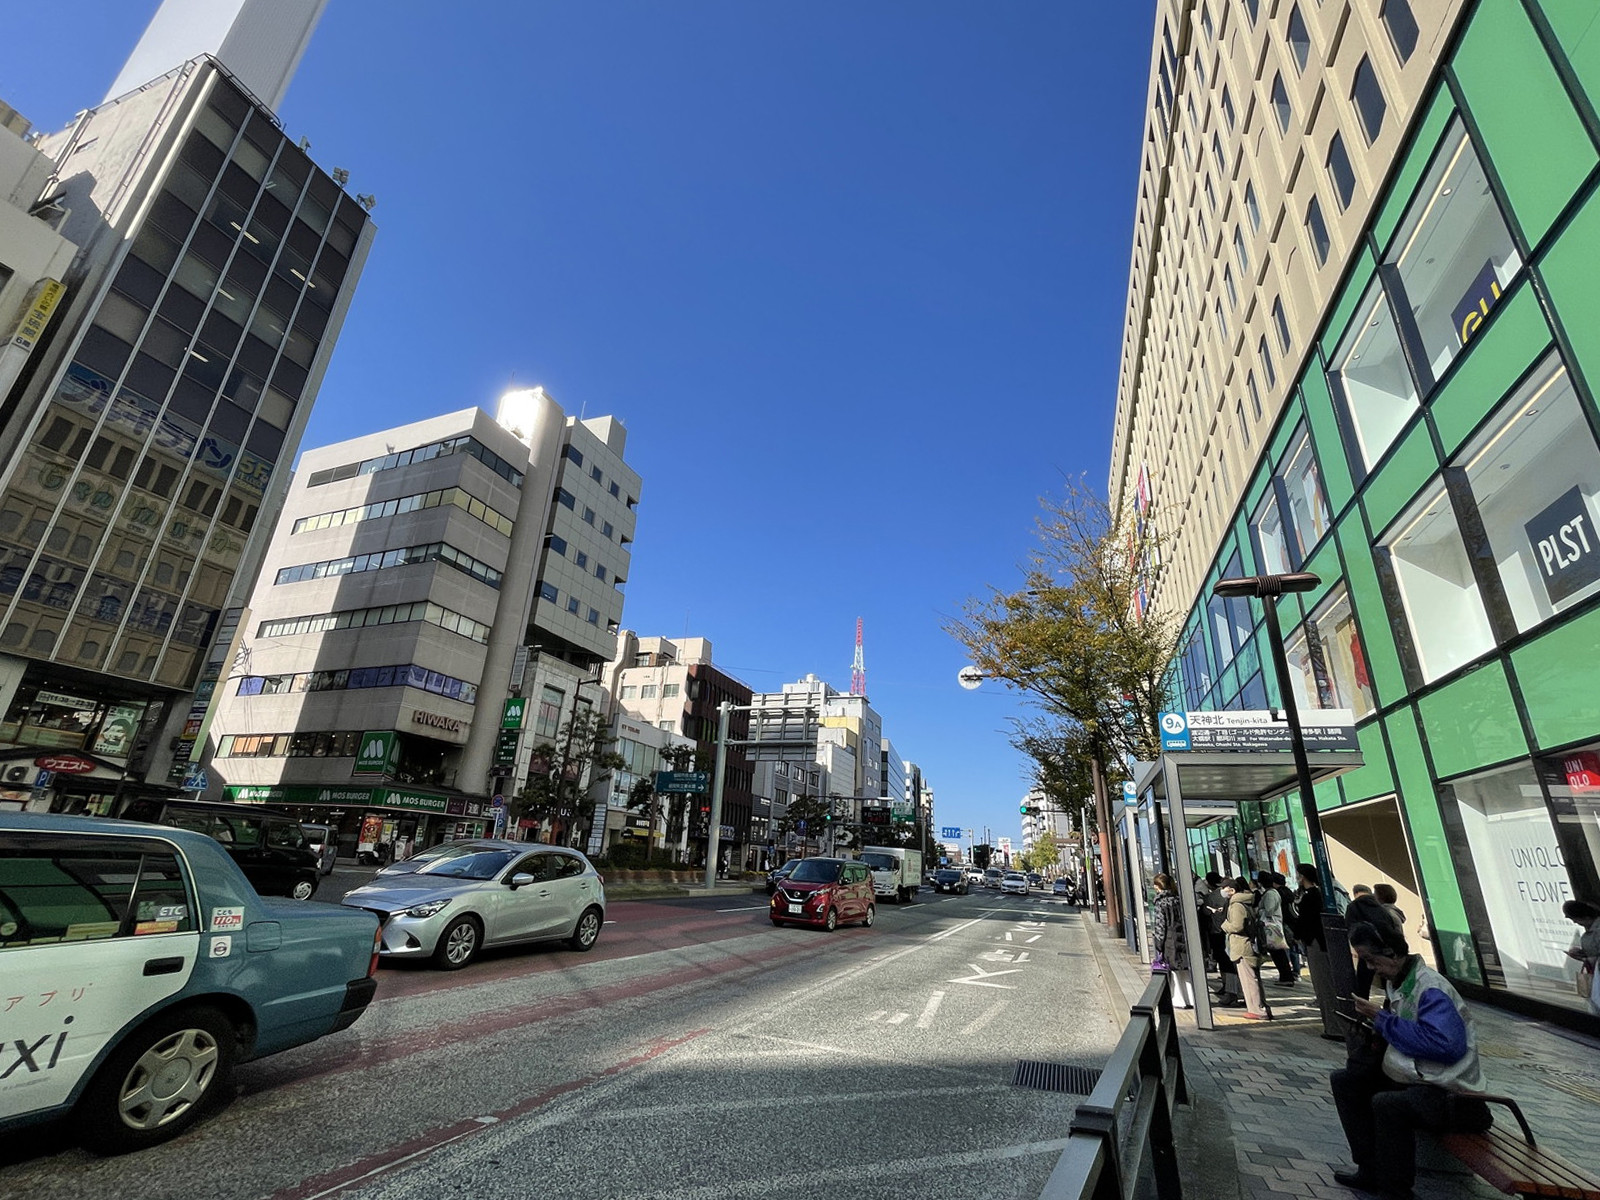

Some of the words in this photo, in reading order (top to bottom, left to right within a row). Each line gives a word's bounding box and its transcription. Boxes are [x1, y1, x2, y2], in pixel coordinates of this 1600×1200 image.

[1538, 514, 1591, 577] PLST
[412, 709, 460, 732] HIWAKA
[1165, 717, 1182, 729] 9A
[1189, 714, 1225, 726] 天神北
[1227, 717, 1268, 726] Tenjin-kita
[44, 759, 90, 770] ウエスト
[1564, 758, 1584, 774] UNI
[1570, 773, 1590, 790] QLO
[332, 791, 349, 801] MOS
[349, 791, 370, 801] BURGER
[402, 796, 419, 806] MOS
[419, 797, 446, 809] BURGER
[1517, 881, 1569, 903] FLOWE
[160, 905, 184, 916] ETC
